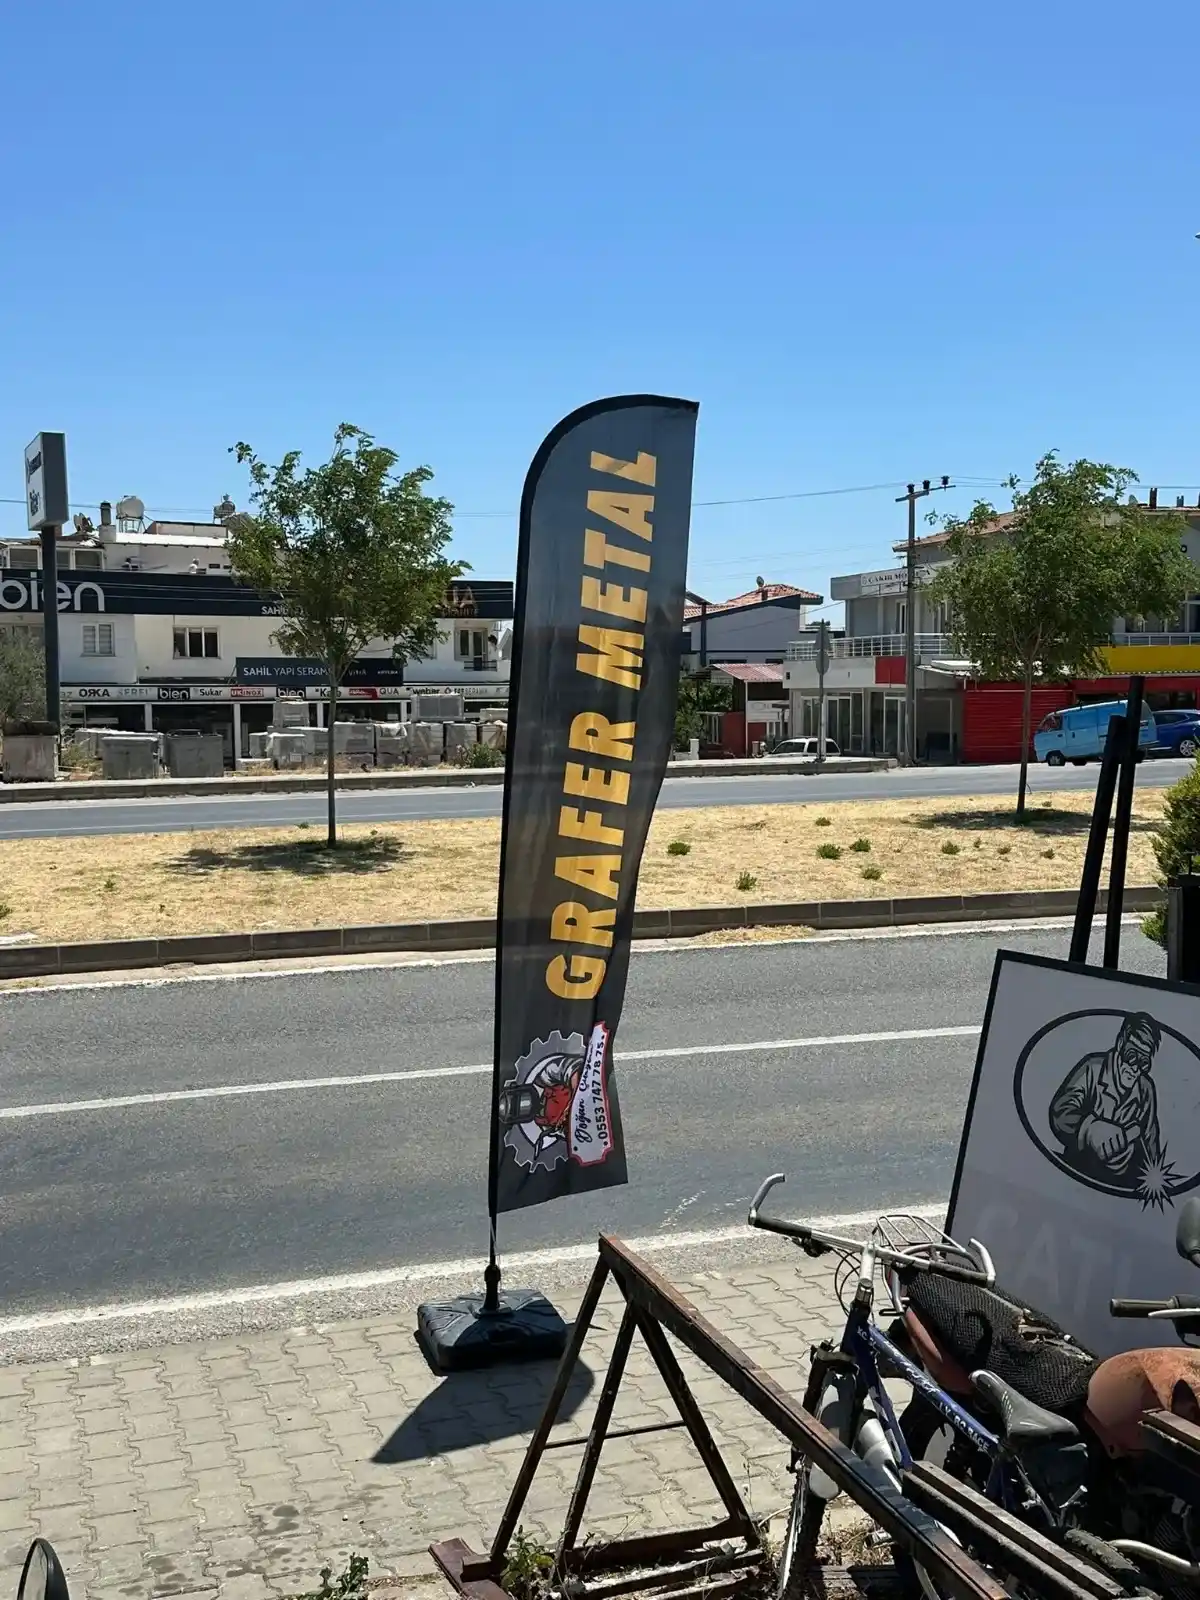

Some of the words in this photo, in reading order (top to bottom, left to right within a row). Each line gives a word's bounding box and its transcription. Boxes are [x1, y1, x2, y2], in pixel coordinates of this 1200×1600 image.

[576, 450, 657, 691] METAL
[243, 665, 272, 676] SAHİL
[273, 667, 295, 676] YAPI
[296, 667, 331, 677] SERAM
[160, 687, 189, 700] bien
[200, 688, 222, 697] Sukar
[545, 711, 636, 1000] GRAFER
[592, 1061, 602, 1078] 78
[592, 1080, 603, 1104] 747
[574, 1098, 593, 1143] Doğan
[594, 1107, 608, 1140] 0553
